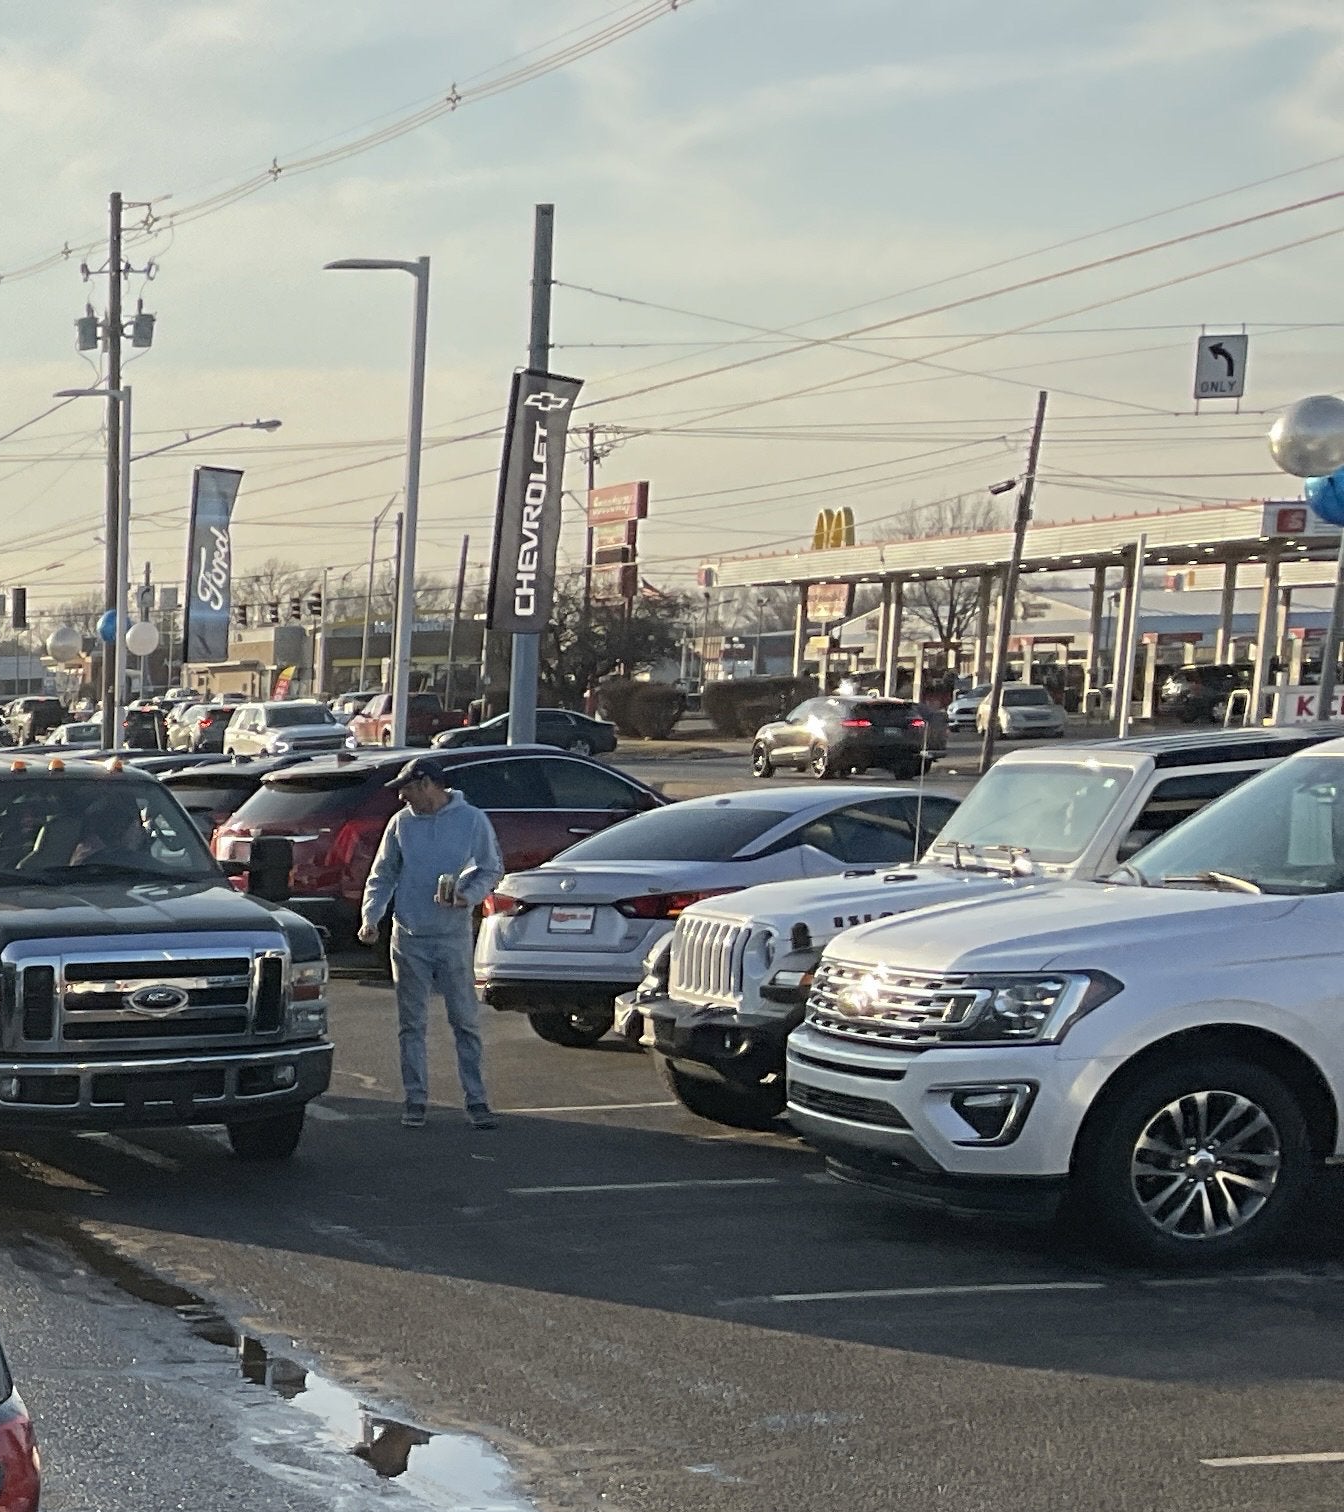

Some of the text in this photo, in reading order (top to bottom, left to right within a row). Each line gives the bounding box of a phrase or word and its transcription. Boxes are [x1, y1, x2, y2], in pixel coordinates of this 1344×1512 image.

[1200, 381, 1237, 393] ONLY
[514, 420, 548, 616] CHEVROLET
[198, 525, 229, 611] Ford
